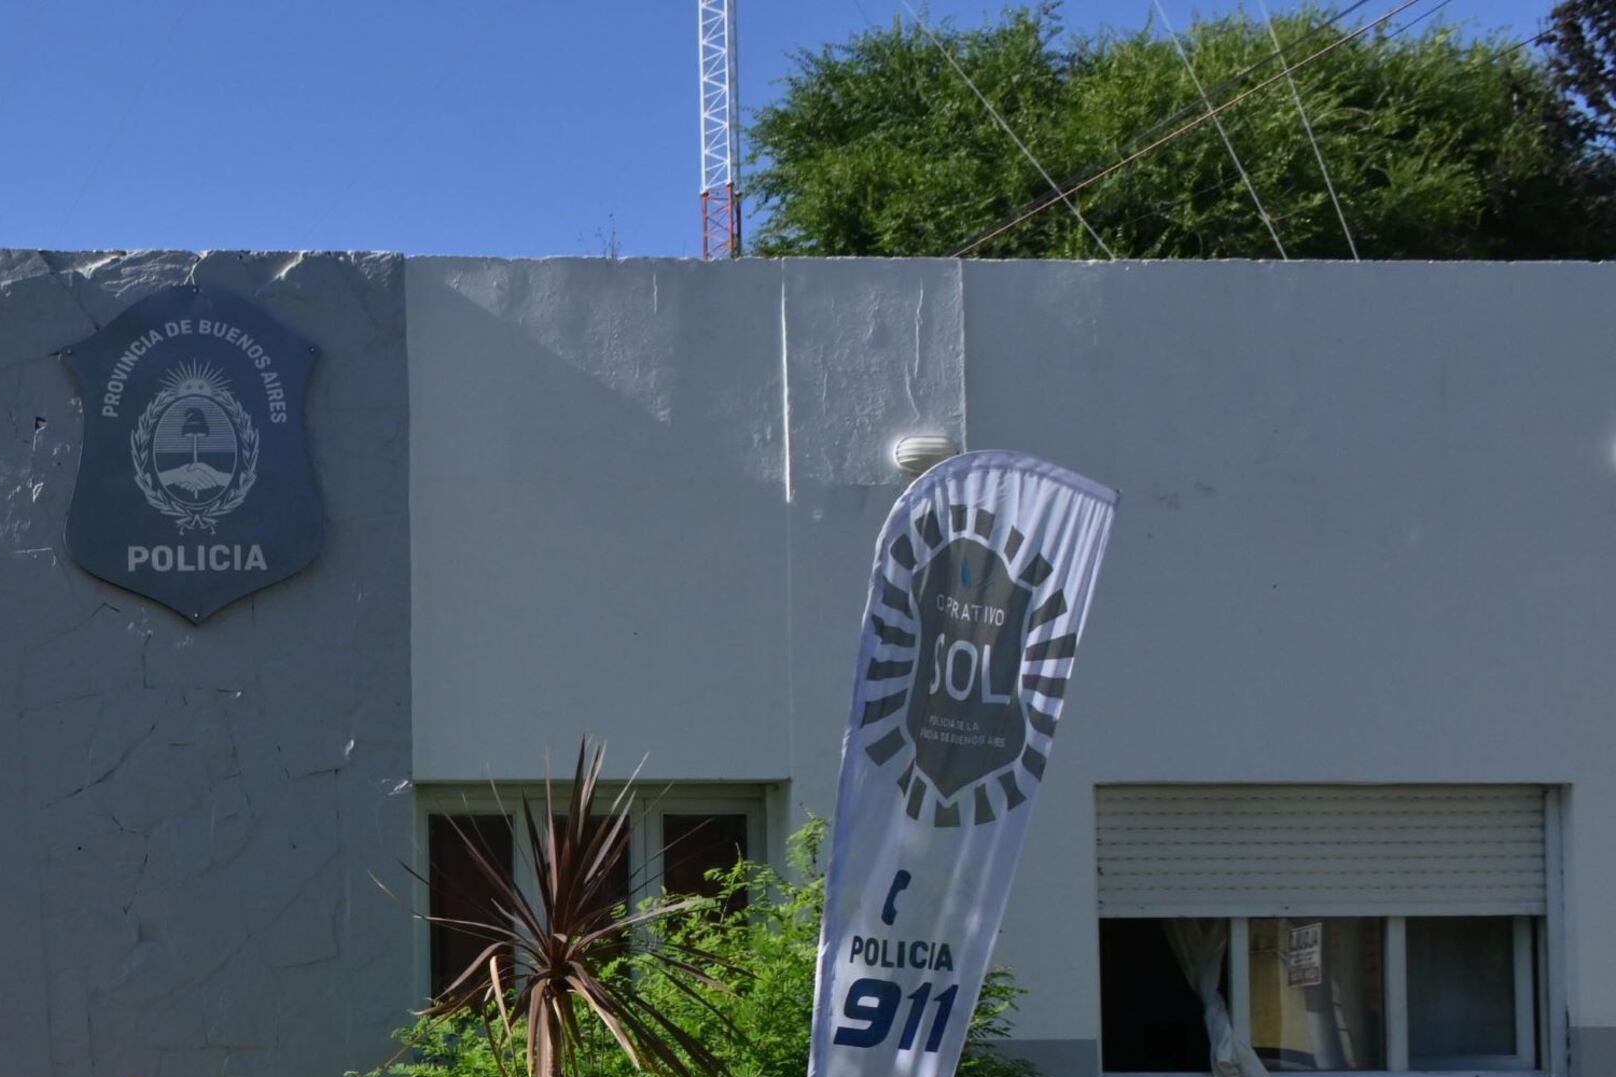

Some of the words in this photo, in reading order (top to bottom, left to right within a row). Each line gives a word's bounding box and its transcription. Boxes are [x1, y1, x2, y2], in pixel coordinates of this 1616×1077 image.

[102, 329, 164, 418] PROVINCIA
[165, 319, 193, 338] DE
[199, 319, 272, 370] BUENOS
[261, 371, 288, 424] AIRES
[127, 544, 268, 572] POLICIA
[936, 594, 1005, 626] OPRATIVO
[929, 633, 1011, 705] SOL
[850, 935, 953, 971] POLICIA
[833, 978, 959, 1053] 911
